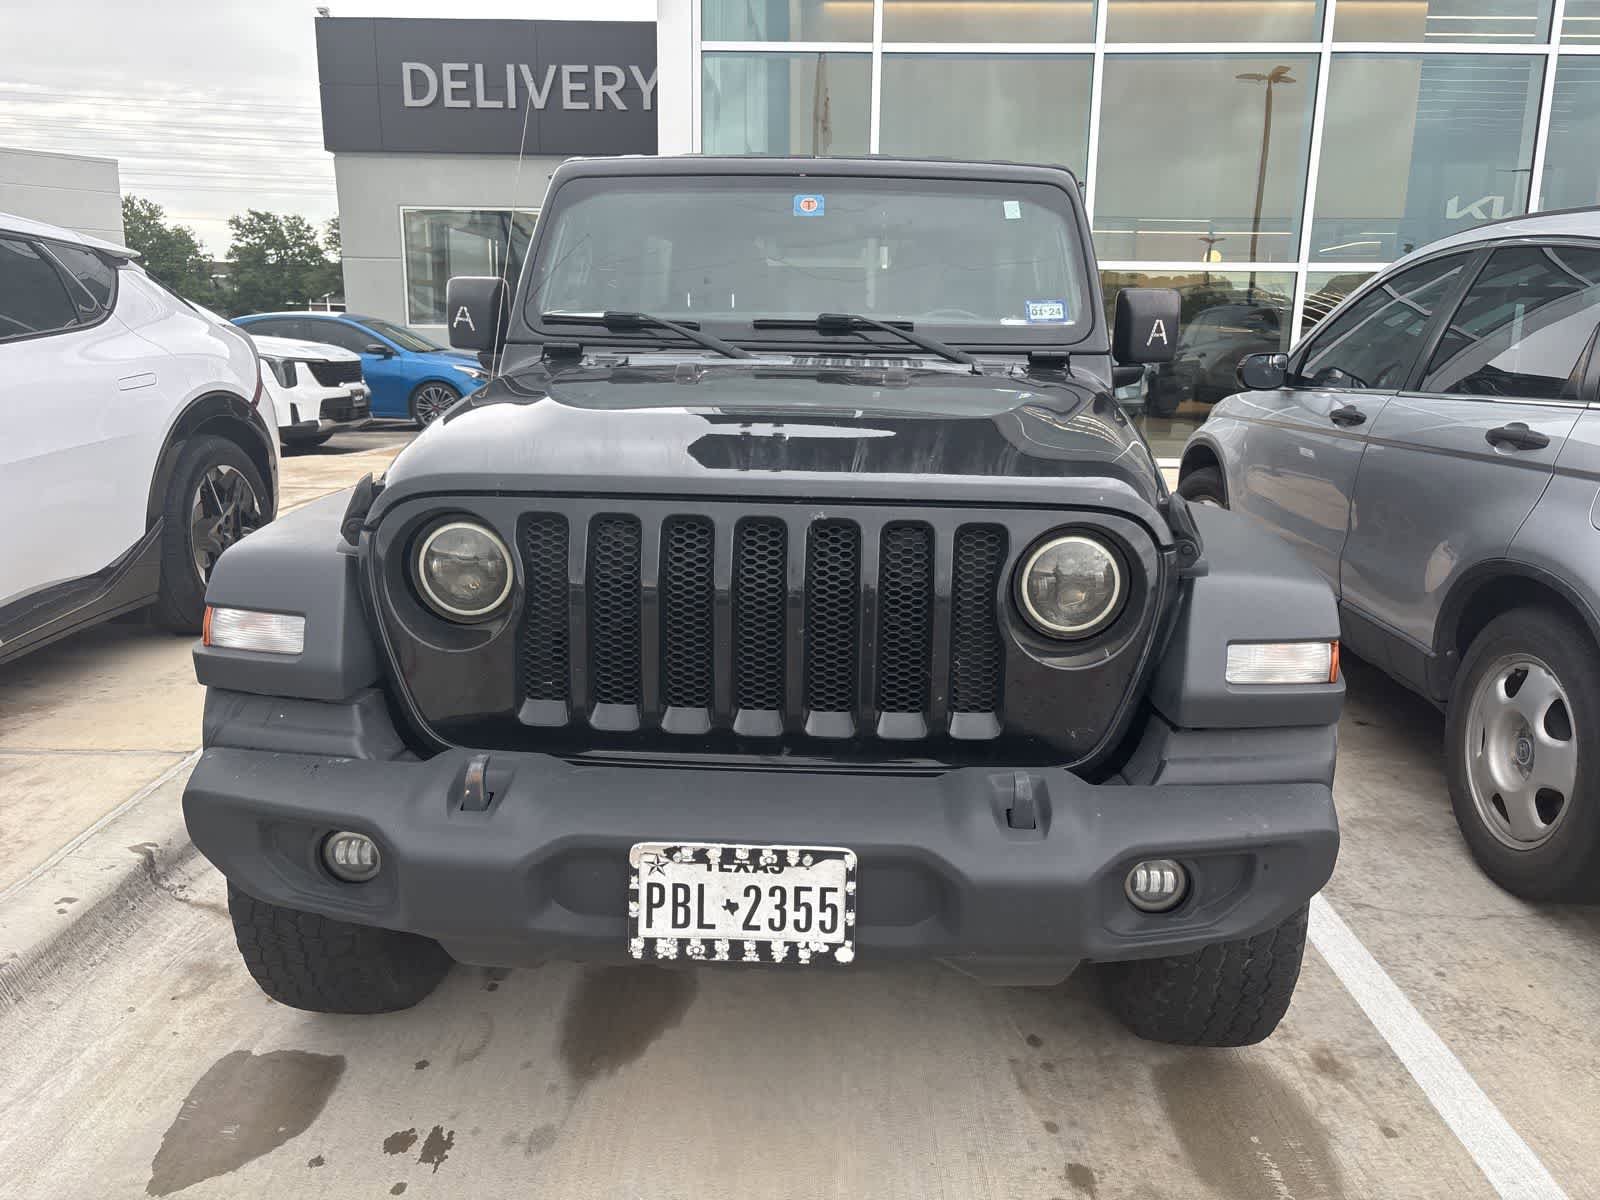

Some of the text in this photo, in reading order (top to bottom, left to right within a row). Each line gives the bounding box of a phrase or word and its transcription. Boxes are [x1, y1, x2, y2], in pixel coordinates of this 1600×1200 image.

[401, 61, 657, 110] DELIVERY
[1446, 194, 1532, 220] KI
[453, 305, 475, 331] A
[1146, 319, 1168, 346] A
[645, 882, 839, 934] PBL 2355
